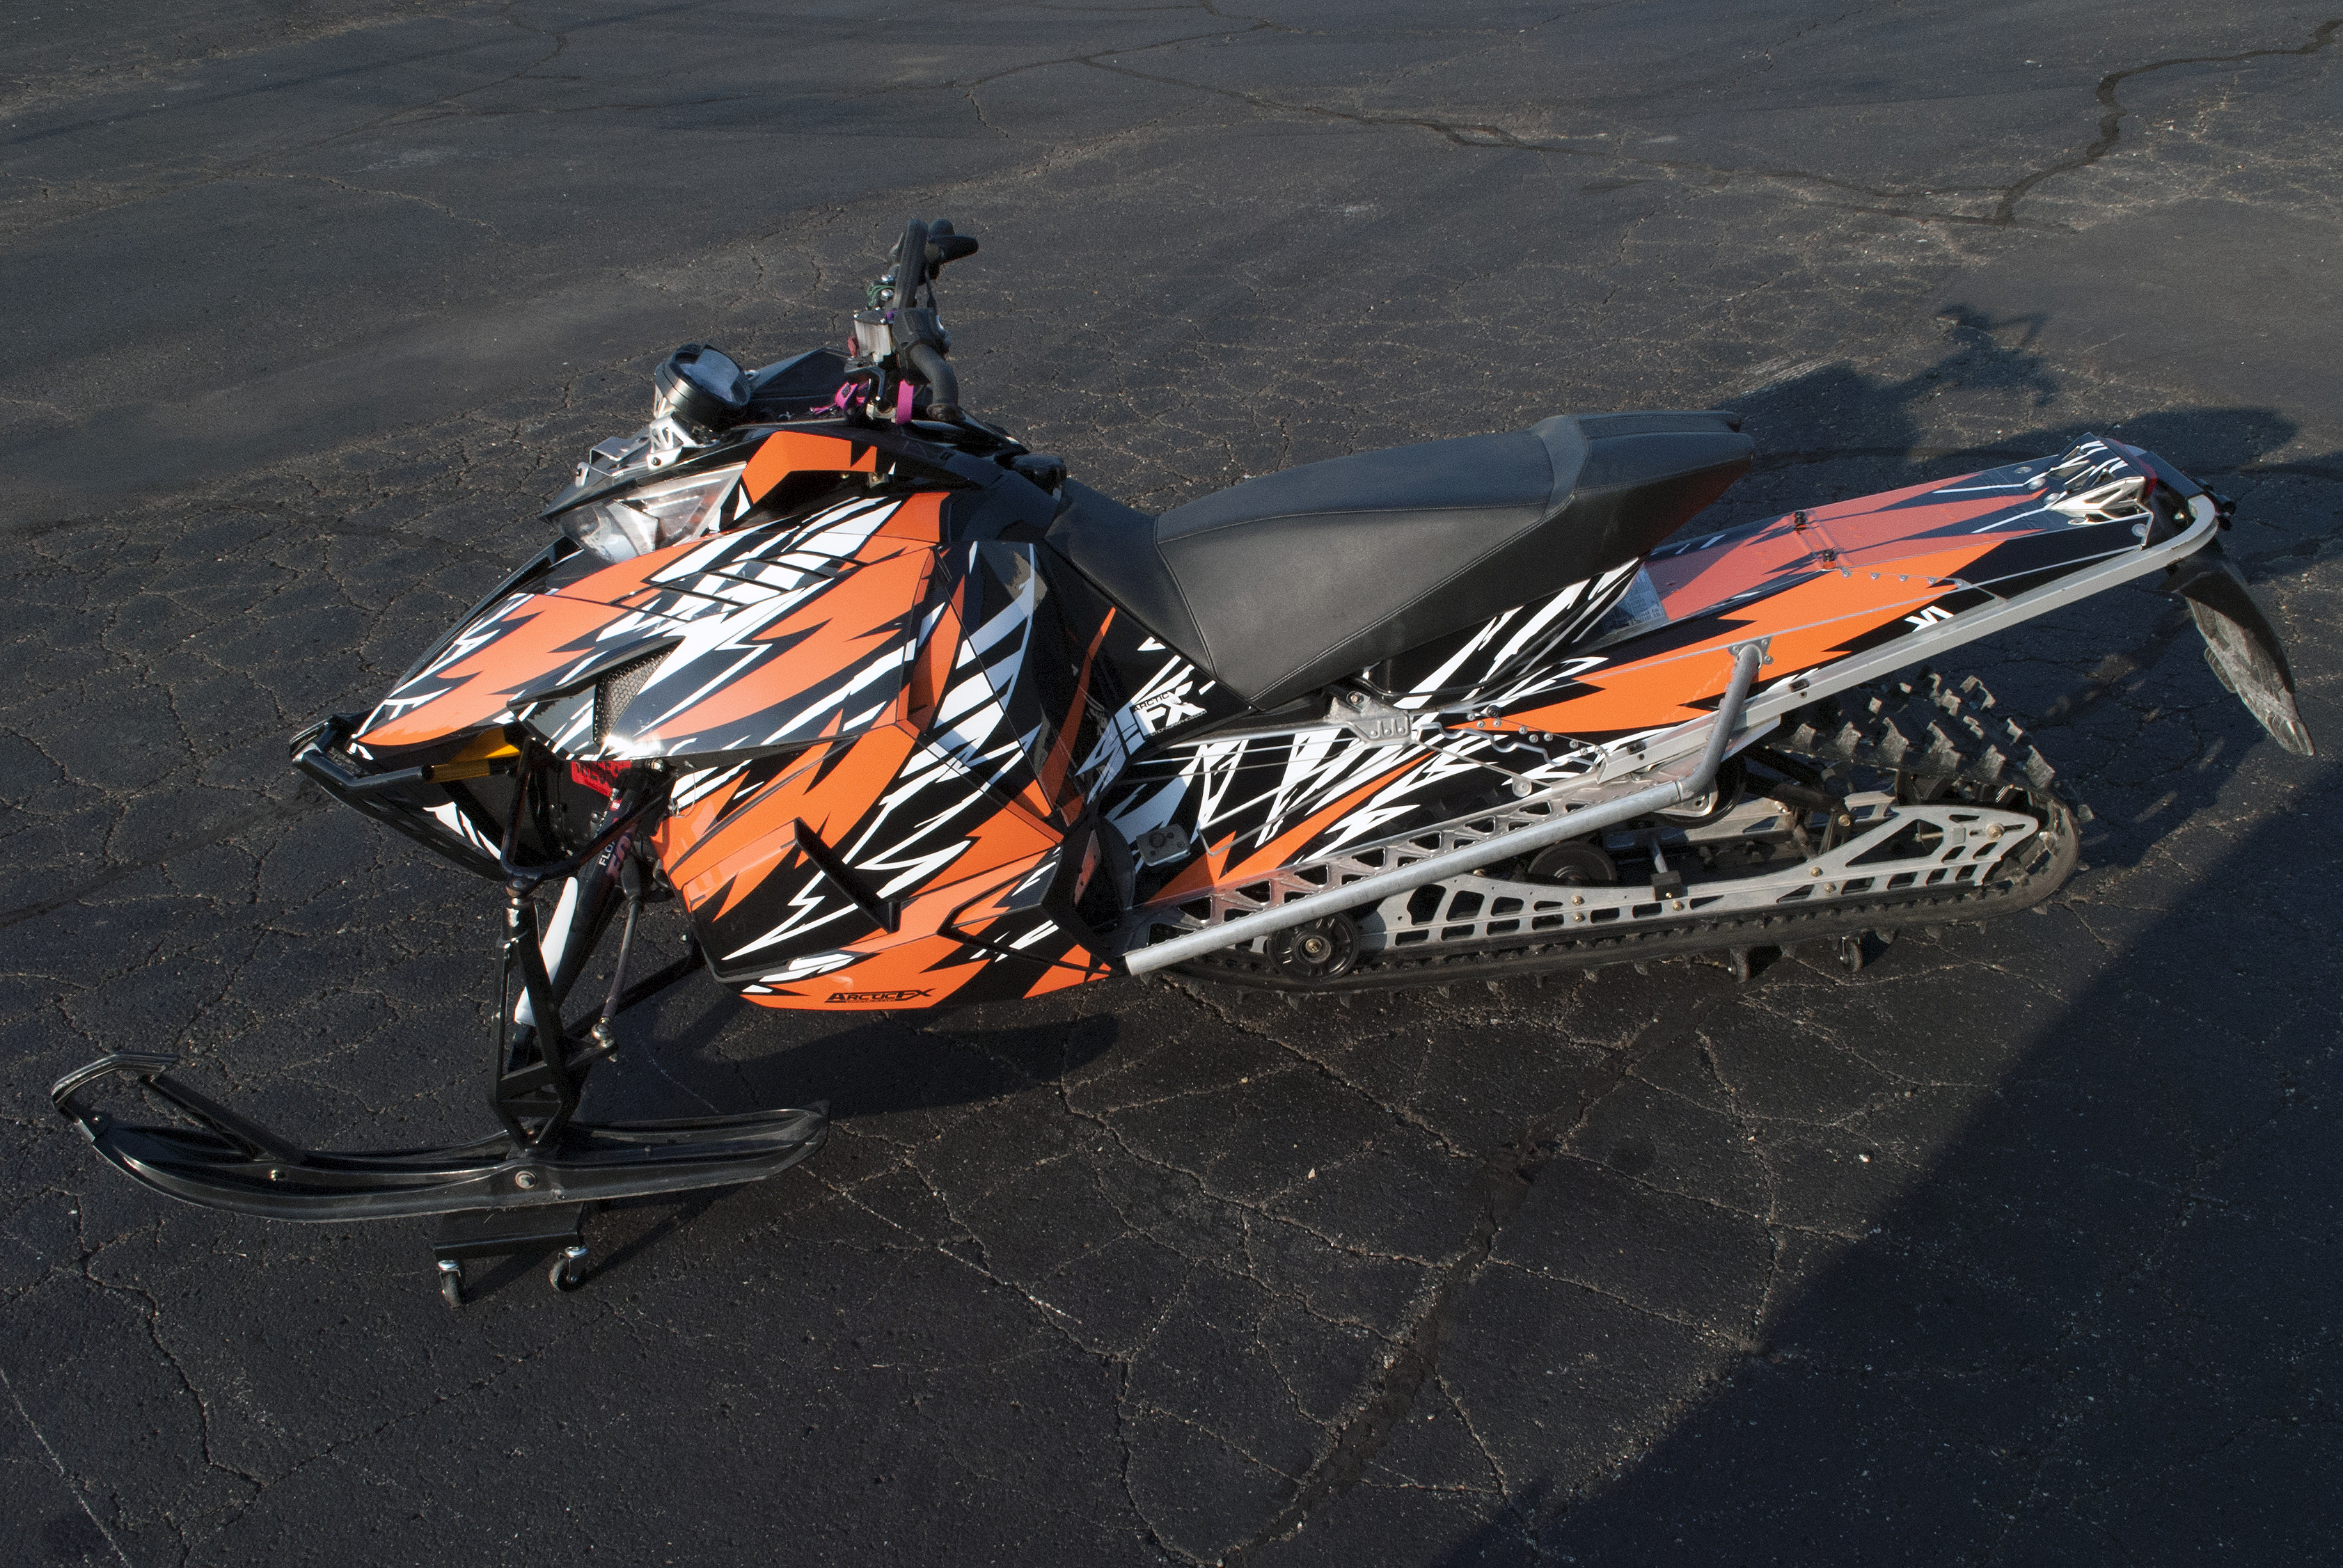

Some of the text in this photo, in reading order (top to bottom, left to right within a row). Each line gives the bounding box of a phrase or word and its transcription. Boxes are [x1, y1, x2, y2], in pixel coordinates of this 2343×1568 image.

[1133, 691, 1169, 711] ARCTIC
[1133, 681, 1206, 736] FX
[599, 841, 615, 866] FLO
